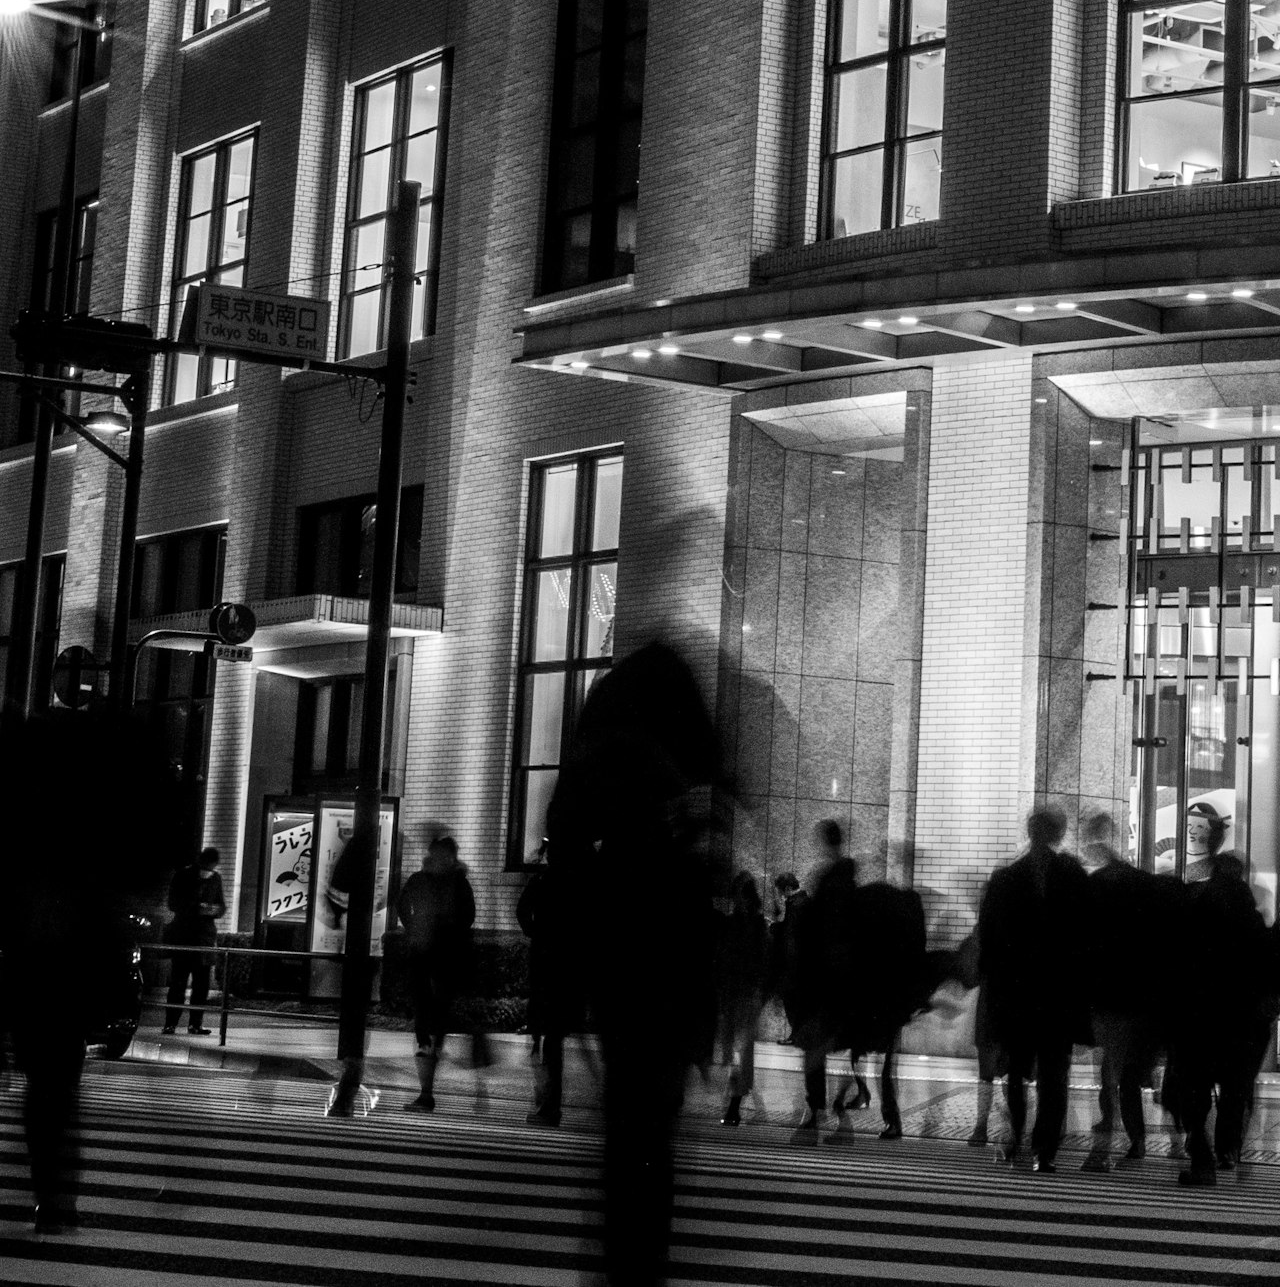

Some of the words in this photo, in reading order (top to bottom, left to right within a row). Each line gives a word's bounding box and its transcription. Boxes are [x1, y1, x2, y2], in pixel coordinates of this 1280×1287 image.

[208, 293, 319, 332] 東京駅南口
[203, 321, 242, 341] Tokyo
[247, 327, 272, 345] Sta.
[278, 332, 290, 347] S.
